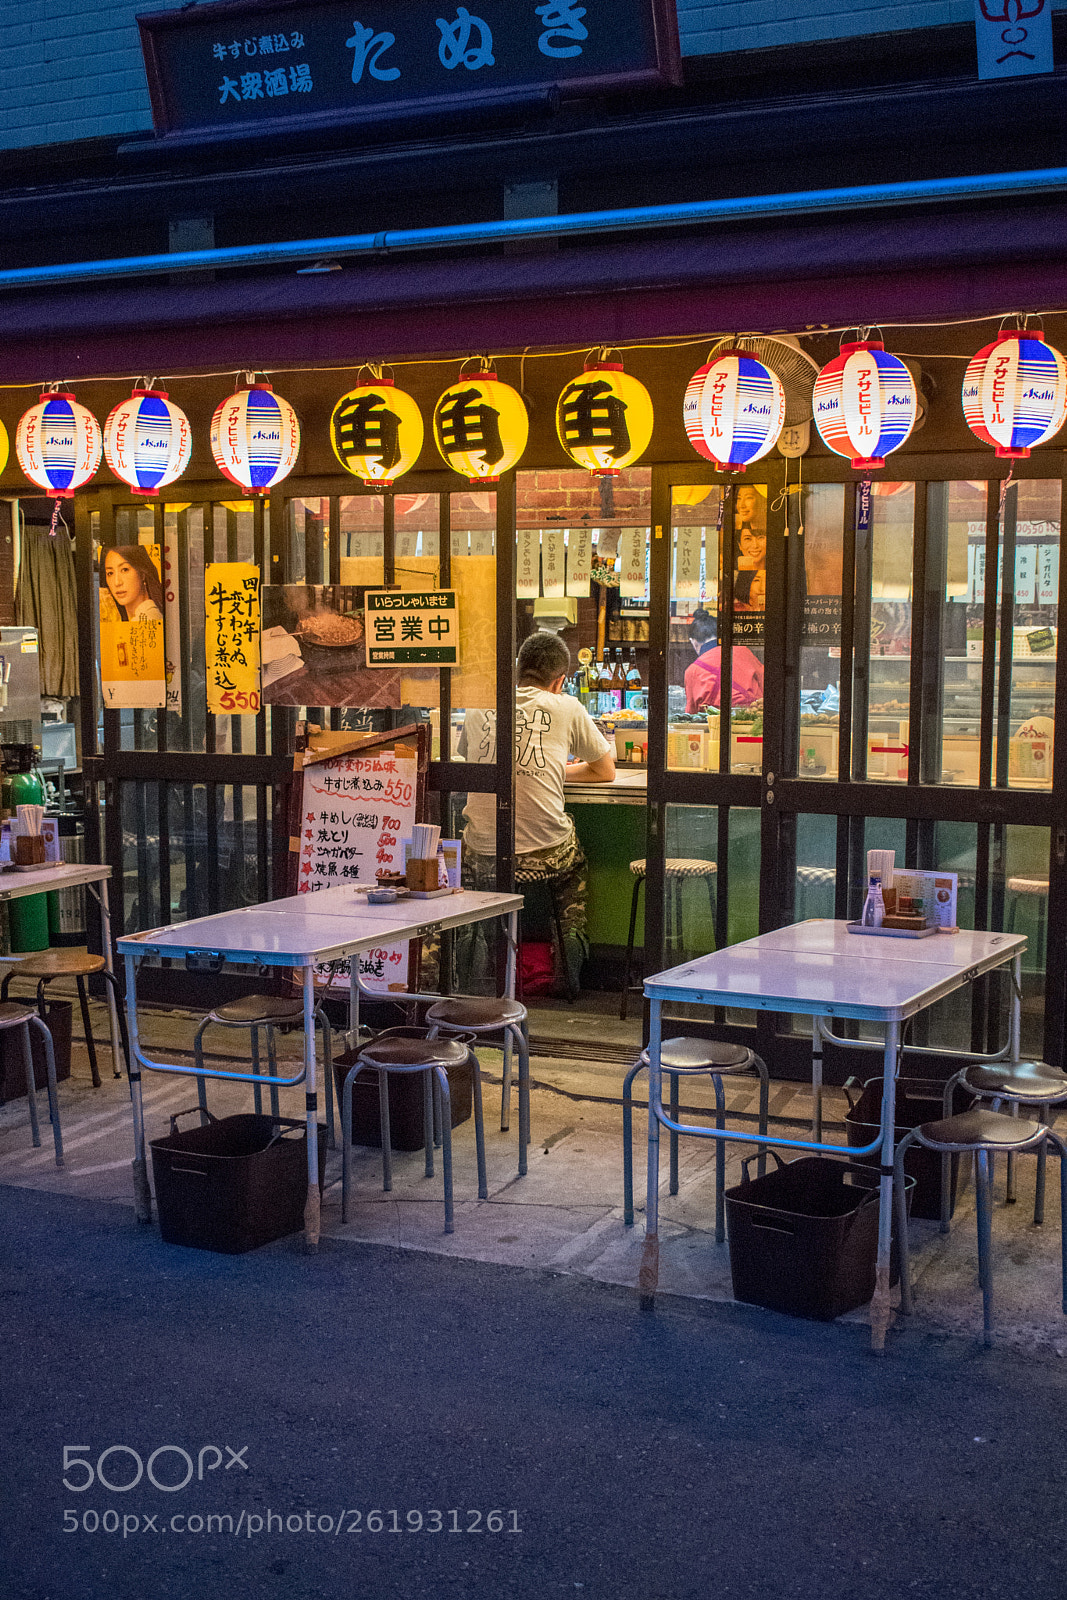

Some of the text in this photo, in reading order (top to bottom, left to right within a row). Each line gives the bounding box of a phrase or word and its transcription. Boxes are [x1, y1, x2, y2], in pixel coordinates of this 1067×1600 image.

[212, 31, 305, 61] 牛すじ煮込み
[218, 63, 314, 105] 大衆酒場
[857, 369, 872, 435] アサヒビール
[887, 394, 912, 406] Asahi
[991, 357, 1010, 424] アサヒビール
[1023, 388, 1054, 400] Asahi
[709, 372, 728, 438] アサヒビール
[743, 403, 771, 415] Asahi
[26, 415, 39, 470] アサヒビール
[46, 437, 73, 447] Asahi
[81, 415, 94, 471] アサヒビール
[116, 412, 130, 469] アサヒビール
[141, 438, 168, 449] Asahi
[228, 406, 242, 464] アサヒビール
[252, 430, 280, 441] Asahi
[858, 481, 872, 524] アサヒビール
[242, 577, 259, 642] 四十年
[375, 595, 448, 608] いらっしゃいませ
[208, 582, 237, 690] 牛すじ煮込
[228, 590, 248, 667] 変わらぬ
[374, 615, 450, 642] 営業中
[372, 651, 395, 660] 営業時間
[219, 691, 259, 711] 550
[324, 777, 412, 800] 牛すじ煮込み 550
[319, 810, 352, 826] 牛めし
[382, 815, 401, 831] 700
[317, 829, 396, 848] 焼とり 500
[315, 863, 338, 877] 焼魚
